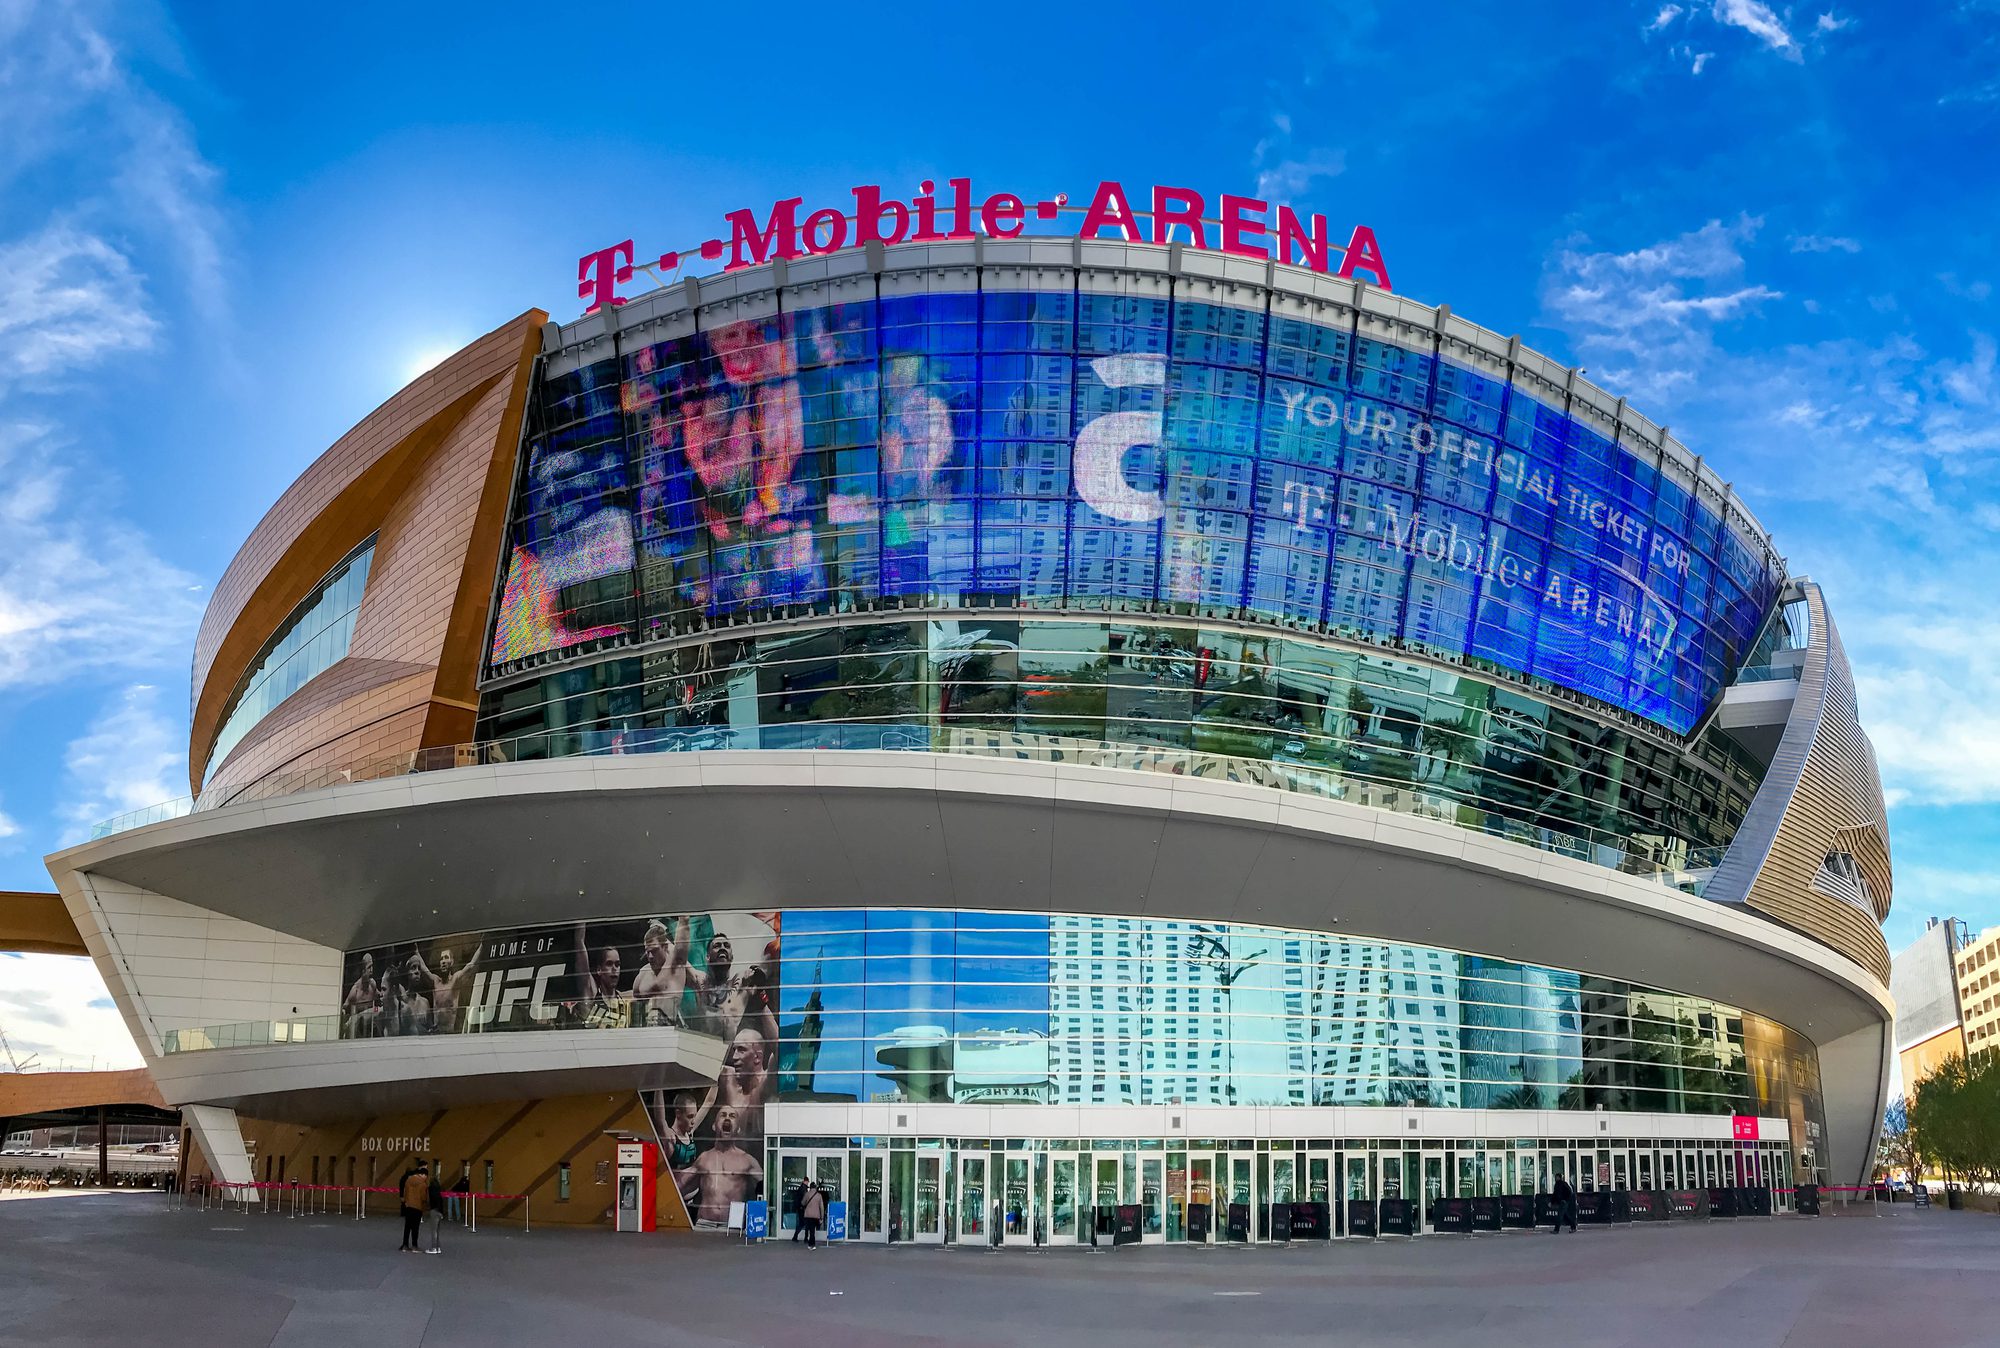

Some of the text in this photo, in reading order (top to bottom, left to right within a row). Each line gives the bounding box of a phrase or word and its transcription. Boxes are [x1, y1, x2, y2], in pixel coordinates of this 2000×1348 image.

[1079, 181, 1392, 290] ARENA
[1278, 385, 1692, 579] YOUR OFFICIAL TICKET FOR
[1542, 574, 1652, 649] ARENA
[489, 937, 554, 958] HOME OF
[467, 963, 567, 1025] UFC
[361, 1136, 430, 1152] BOX OFFICE
